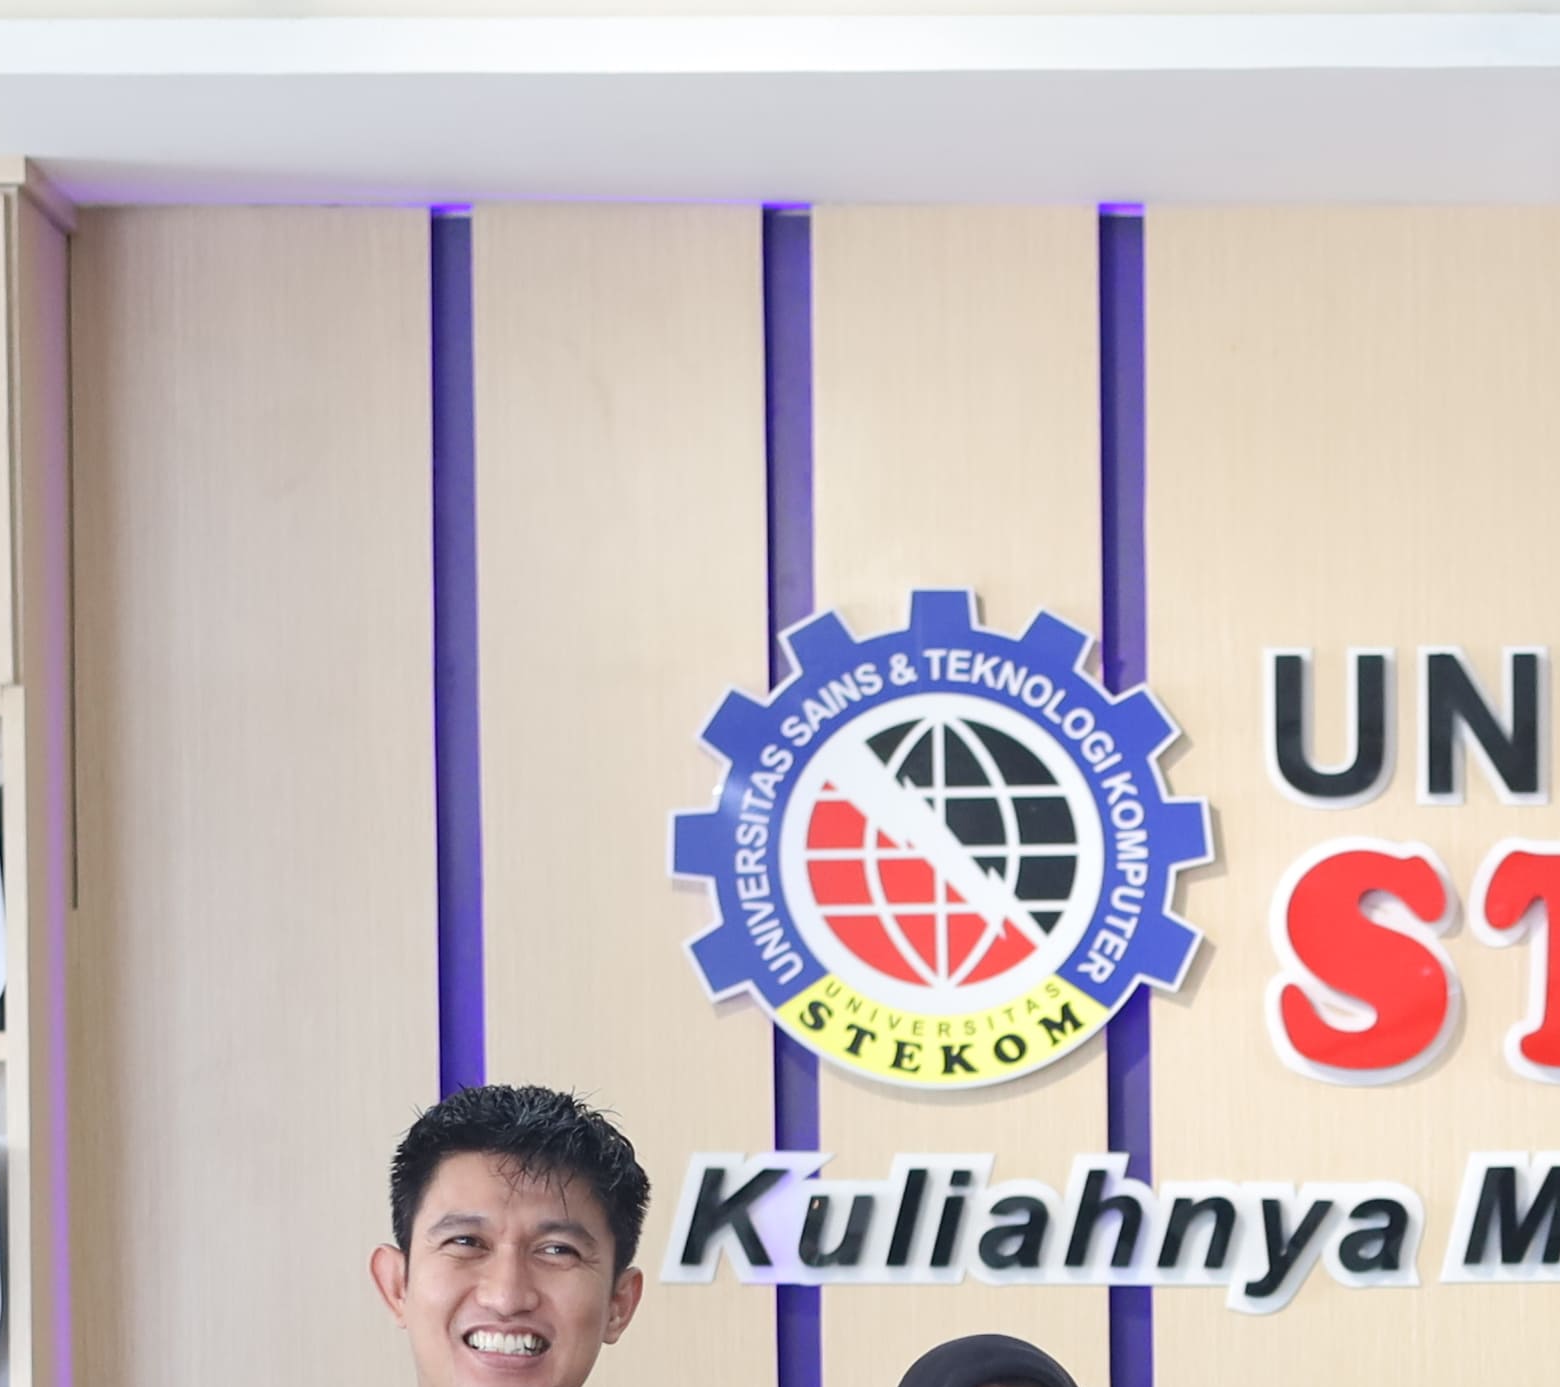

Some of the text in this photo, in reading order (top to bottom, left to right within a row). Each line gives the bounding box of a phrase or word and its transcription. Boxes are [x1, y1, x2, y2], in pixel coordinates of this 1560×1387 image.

[735, 648, 1149, 986] UNIVERSITAS SAINS & TEKNOLOGI KOMPUTER
[798, 999, 1085, 1077] STEKOM
[824, 979, 1064, 1040] UNIVERSITAS
[678, 1165, 1410, 1300] Kuliahnya
